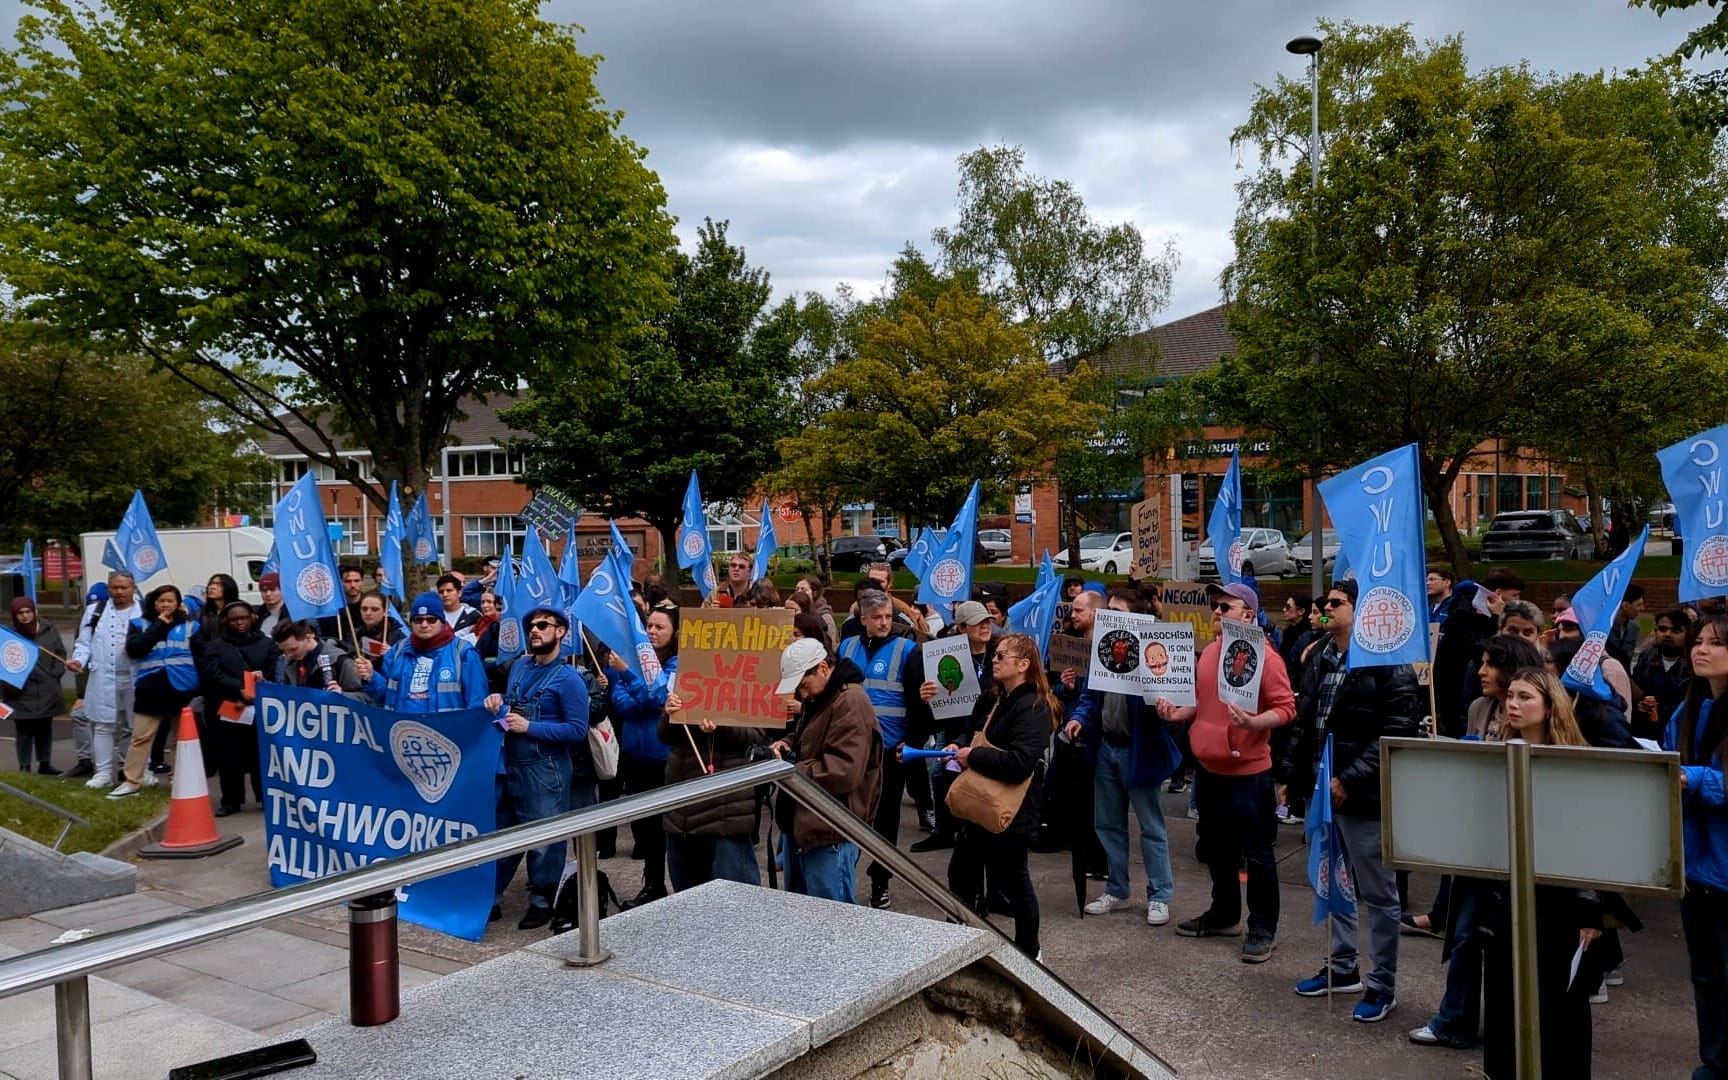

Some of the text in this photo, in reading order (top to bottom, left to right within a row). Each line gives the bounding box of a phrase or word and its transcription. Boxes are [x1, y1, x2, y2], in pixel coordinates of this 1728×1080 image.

[681, 616, 795, 651] META HIDE
[1140, 630, 1193, 640] MASOCHISM
[940, 643, 968, 655] BLOODED
[1168, 644, 1193, 653] IS ONLY
[1173, 655, 1187, 663] FUN
[713, 653, 760, 682] WE
[1171, 665, 1191, 673] WHEN
[1142, 676, 1194, 685] CONSENSUAL
[680, 671, 795, 720] STRIKE
[261, 697, 384, 752] DIGITAL
[267, 744, 335, 788] AND
